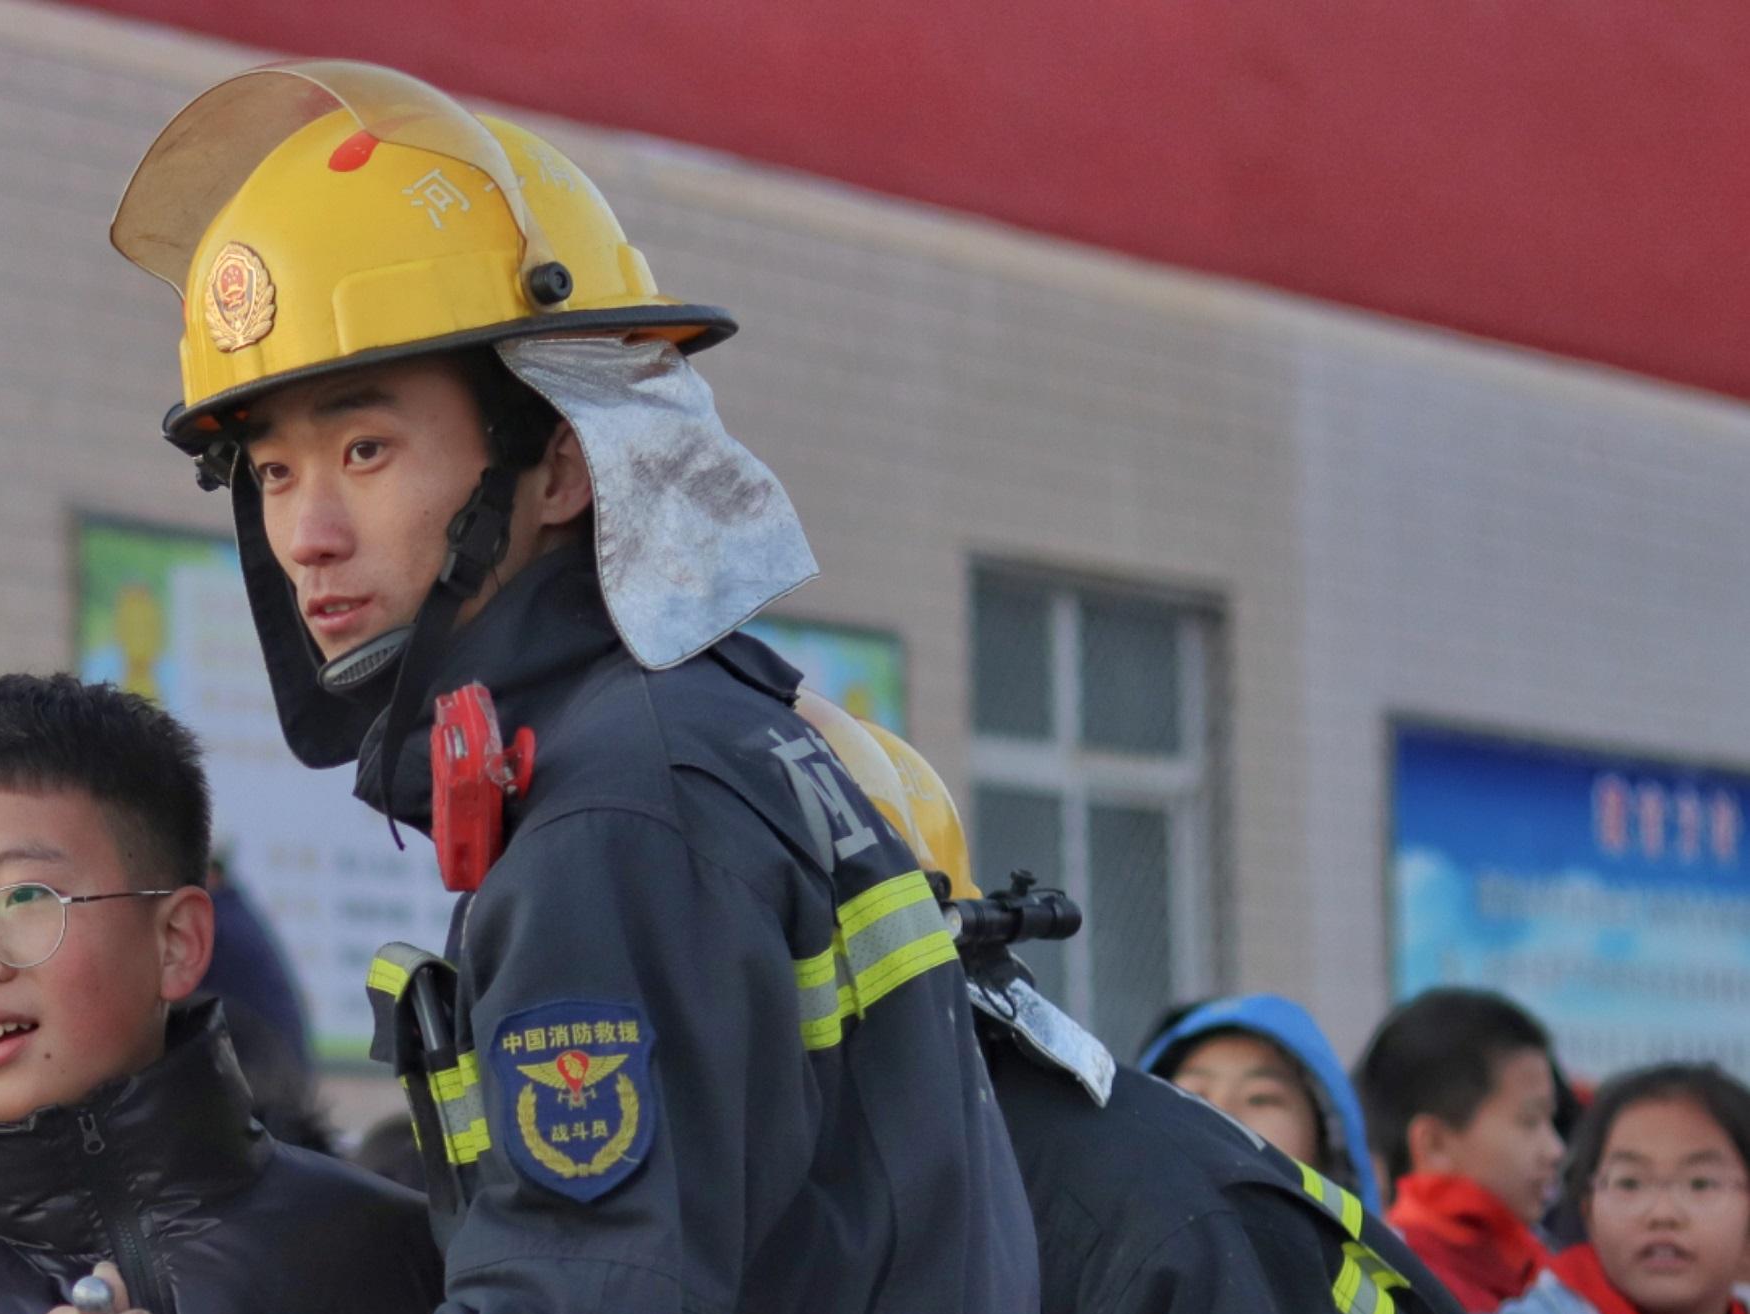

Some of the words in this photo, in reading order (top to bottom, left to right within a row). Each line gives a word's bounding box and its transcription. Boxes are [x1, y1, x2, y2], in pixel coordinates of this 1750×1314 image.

[502, 1020, 640, 1056] 中国消防救援
[551, 1119, 608, 1143] 战斗员
